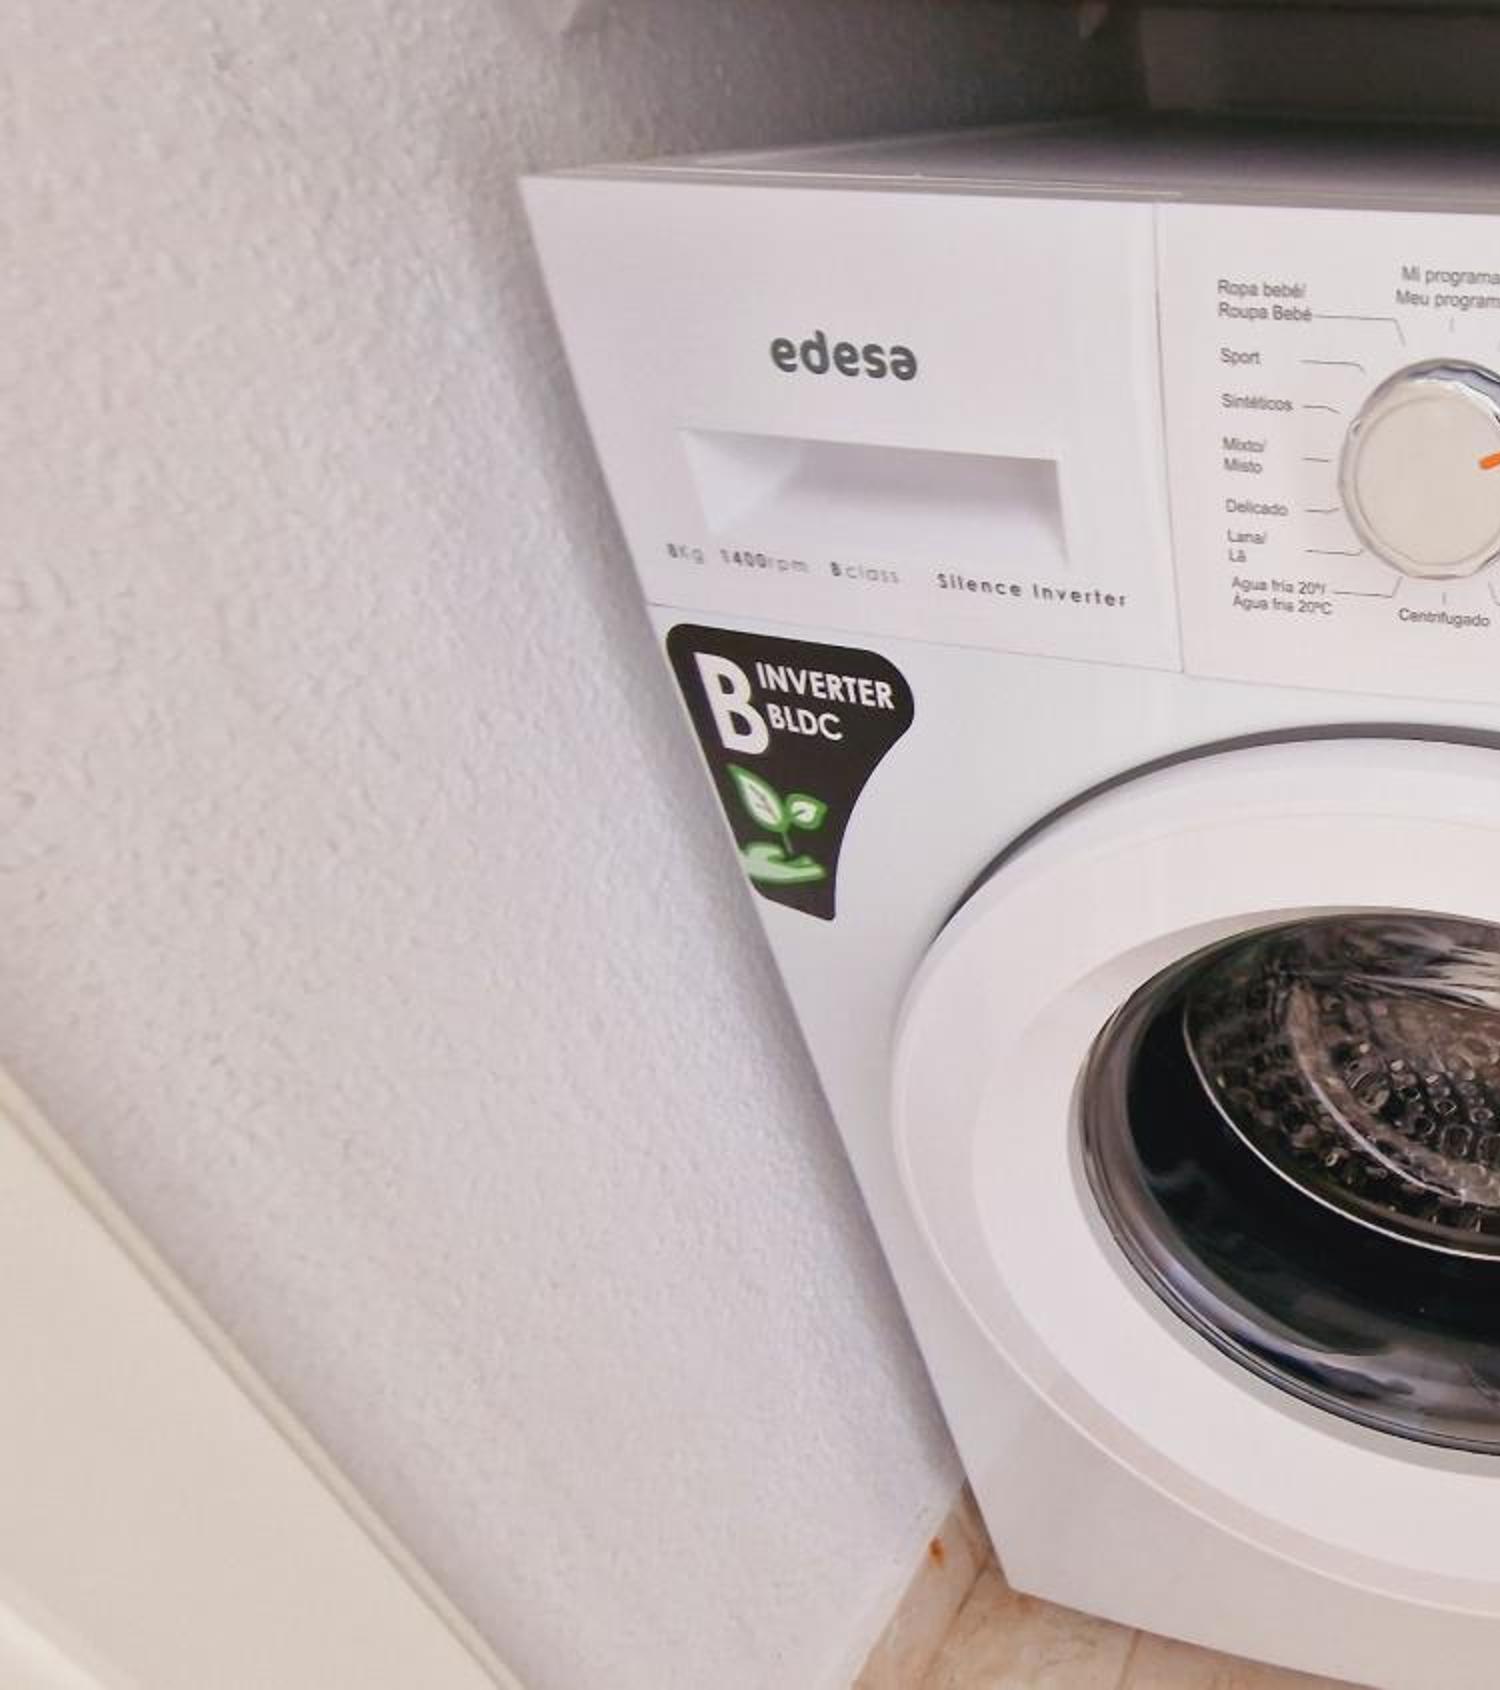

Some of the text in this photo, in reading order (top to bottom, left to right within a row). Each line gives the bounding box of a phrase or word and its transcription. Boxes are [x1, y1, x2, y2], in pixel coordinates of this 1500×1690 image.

[1401, 265, 1420, 282] Mi
[1217, 279, 1259, 299] Ropa
[1396, 288, 1430, 307] Meu
[1219, 300, 1312, 322] Roupa Bebé
[769, 330, 918, 382] edesa
[1219, 347, 1261, 366] Sport
[1224, 458, 1263, 474] Misto
[1225, 499, 1289, 516] Delicado
[937, 572, 1024, 599] Silence
[1033, 583, 1129, 607] Inverter
[1399, 608, 1491, 629] Centrifugado
[756, 661, 895, 710] INVERTER
[694, 651, 769, 755] B
[766, 703, 843, 741] BLDC
